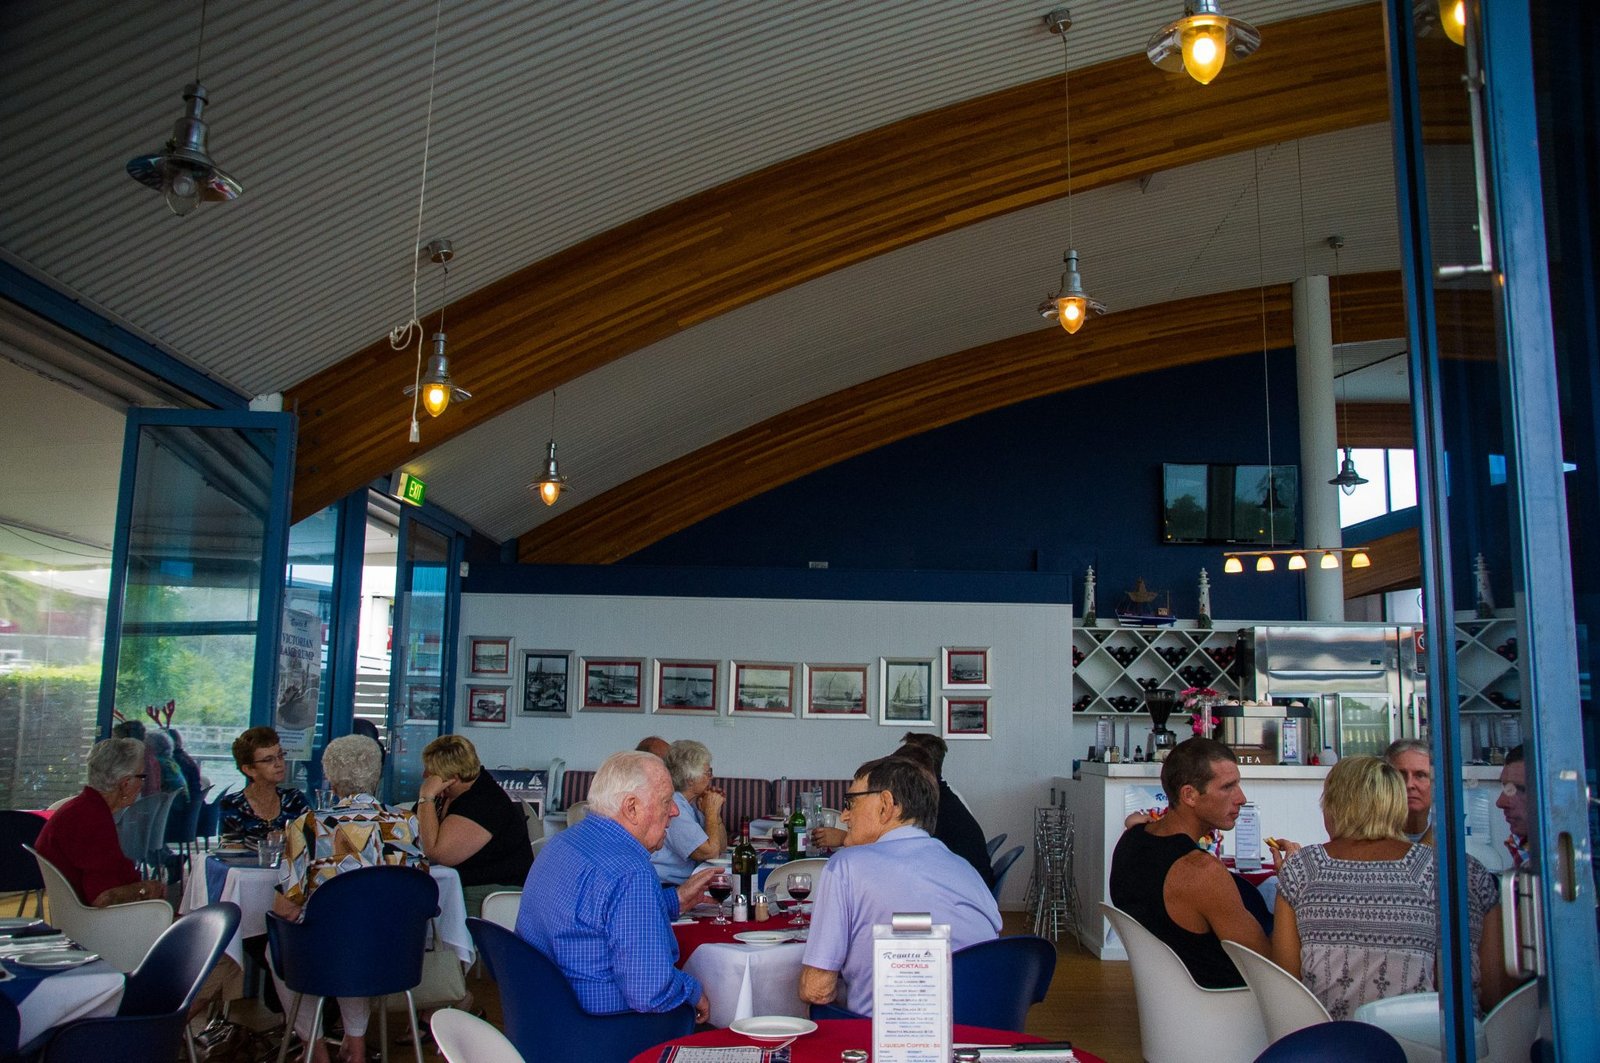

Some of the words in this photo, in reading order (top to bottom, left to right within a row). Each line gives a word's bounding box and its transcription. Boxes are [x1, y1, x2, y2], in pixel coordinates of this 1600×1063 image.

[409, 480, 423, 501] EXIT
[282, 632, 313, 649] VICTORIAN
[1238, 756, 1261, 764] TEA
[883, 952, 921, 960] Regatta
